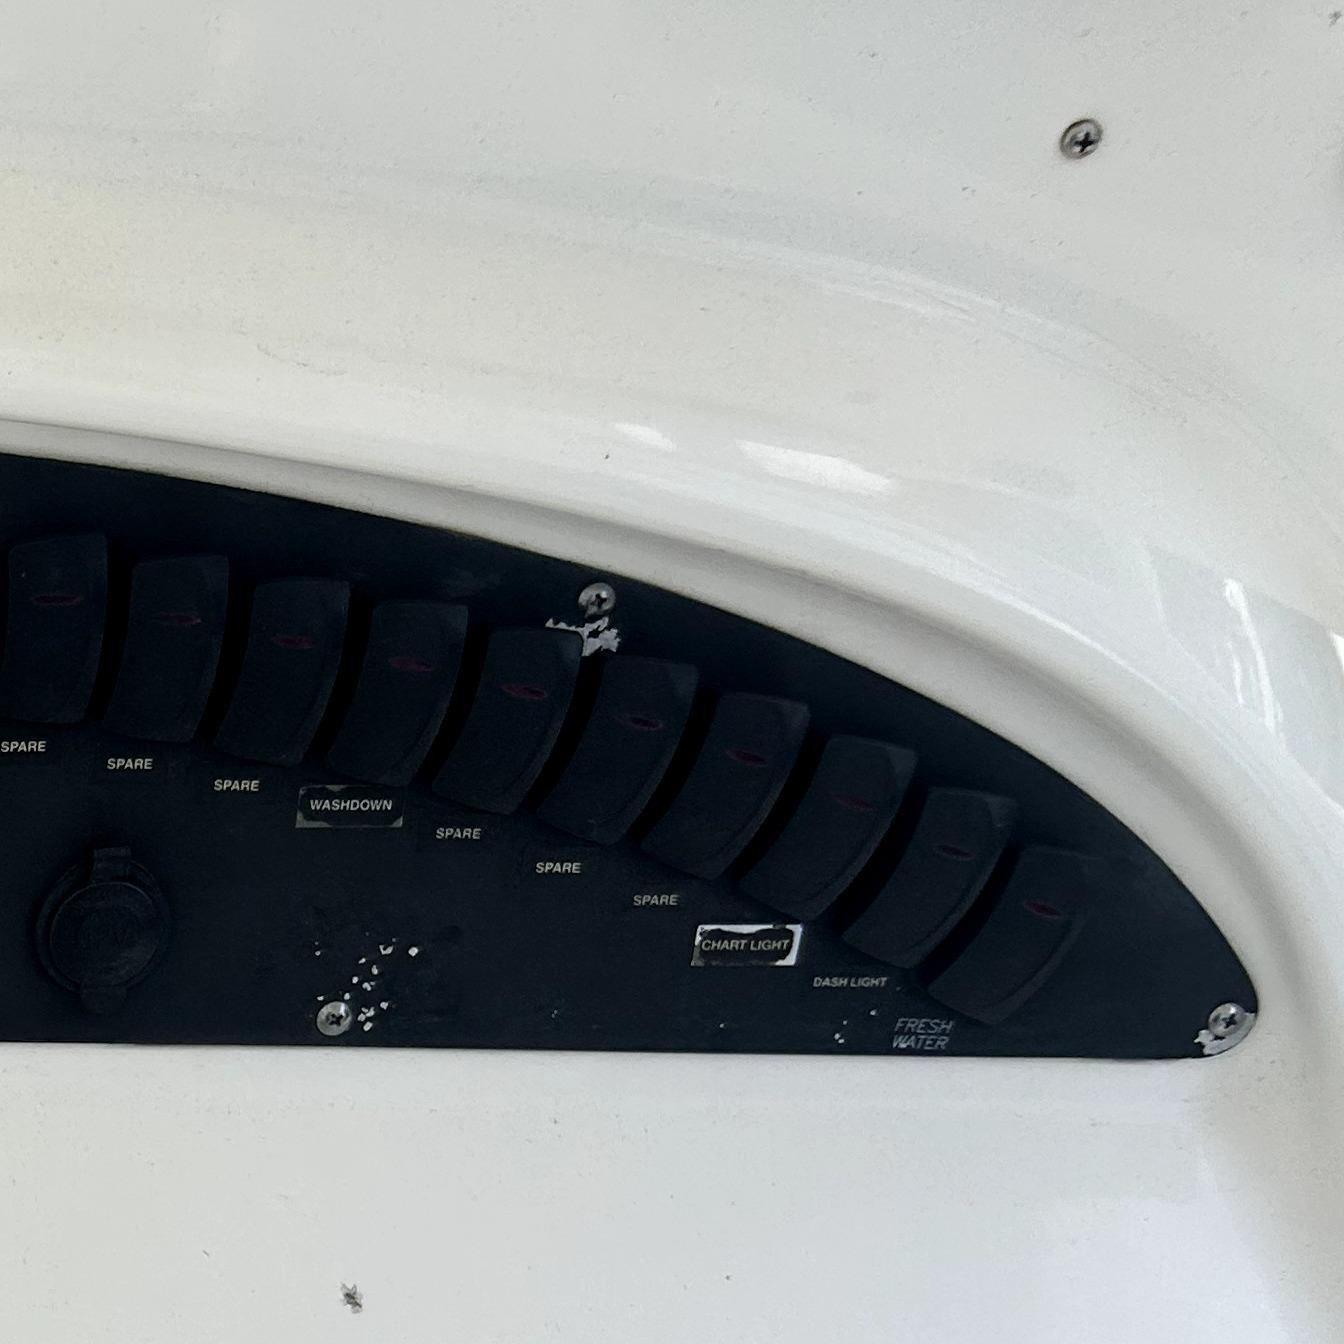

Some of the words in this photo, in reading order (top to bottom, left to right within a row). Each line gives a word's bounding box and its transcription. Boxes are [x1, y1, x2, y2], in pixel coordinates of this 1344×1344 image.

[1, 741, 45, 752] SPARE
[107, 758, 152, 769] SPARE
[214, 779, 259, 791] SPARE
[310, 799, 391, 810] WASHDOWN
[436, 827, 480, 838] SPARE
[536, 862, 580, 873] SPARE
[634, 894, 678, 905] SPARE
[701, 939, 747, 951] CHART
[751, 939, 789, 952] LIGHT
[813, 977, 847, 986] DASH
[850, 977, 887, 986] LIGHT
[895, 1018, 952, 1033] FRESH
[892, 1035, 948, 1049] WATER
